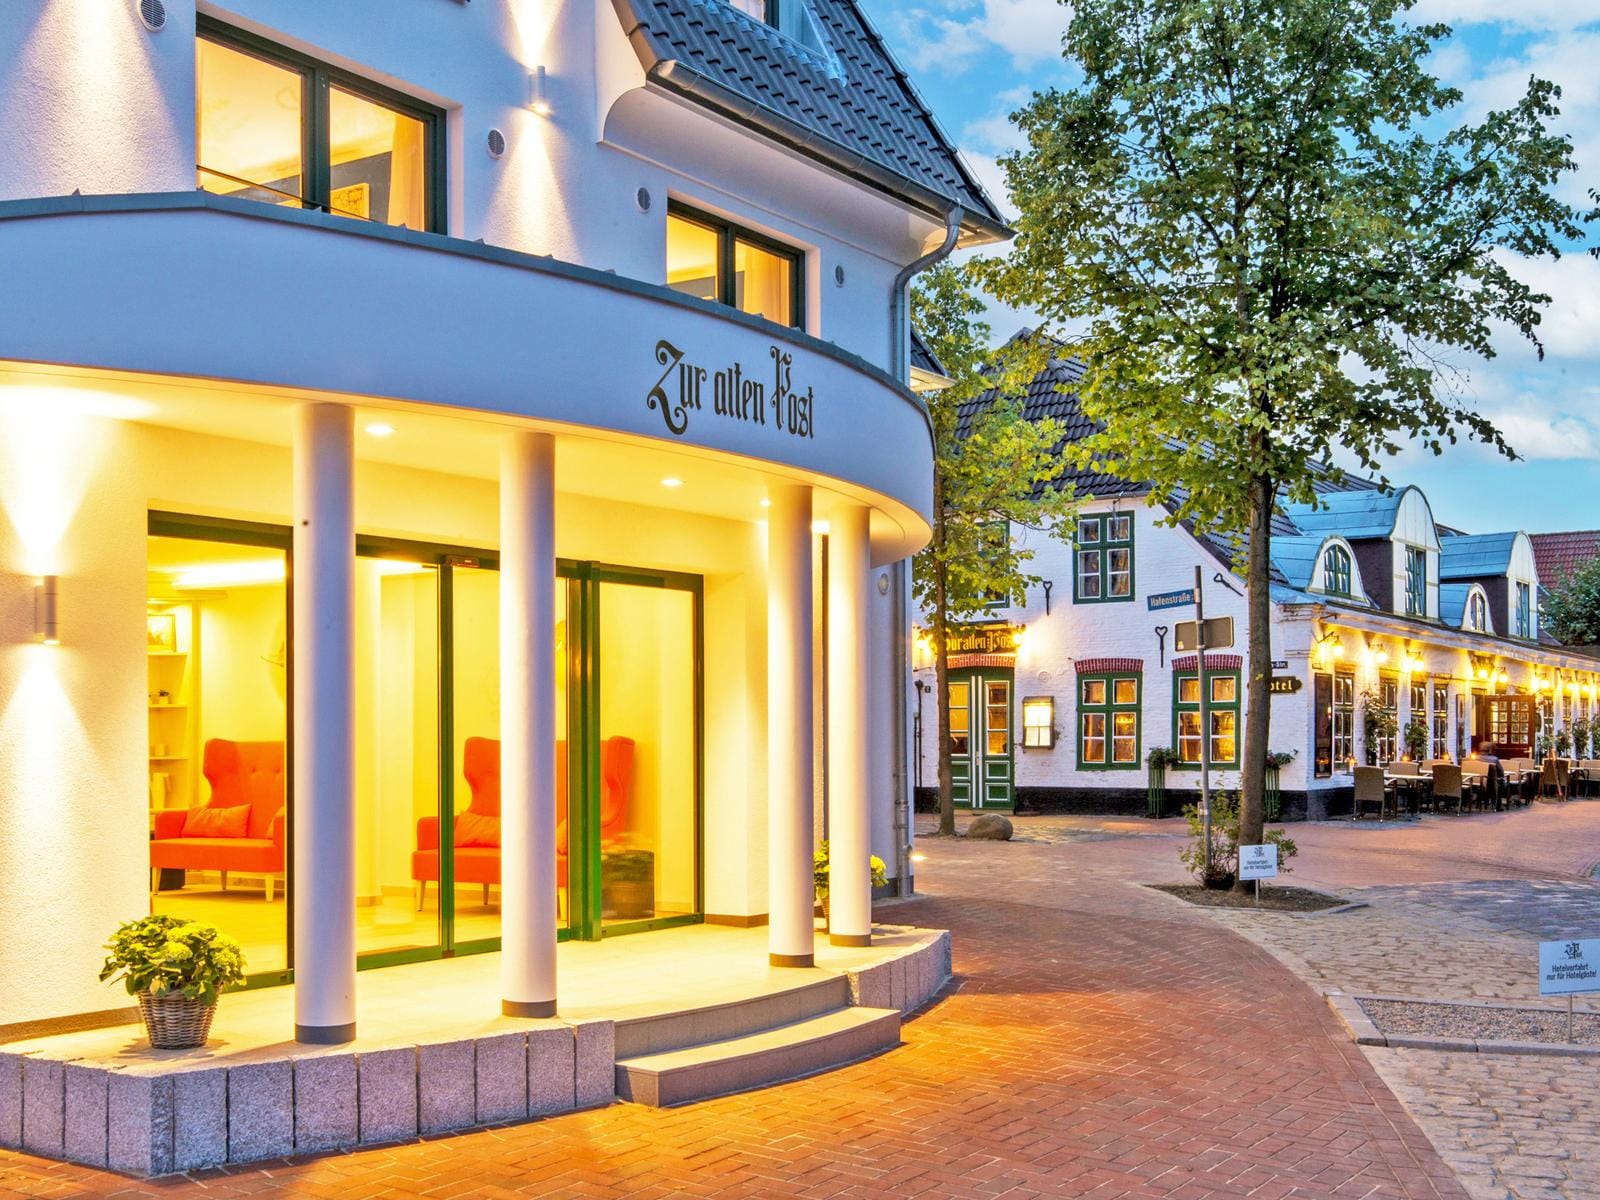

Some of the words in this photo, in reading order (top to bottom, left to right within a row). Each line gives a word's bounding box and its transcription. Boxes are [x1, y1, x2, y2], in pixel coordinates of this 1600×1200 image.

[646, 339, 708, 435] Zur
[713, 362, 766, 426] alten
[769, 345, 814, 439] Post
[1150, 592, 1191, 607] Hafenstraße
[962, 633, 986, 650] alten
[986, 630, 1014, 653] Pos
[1270, 679, 1293, 690] otel
